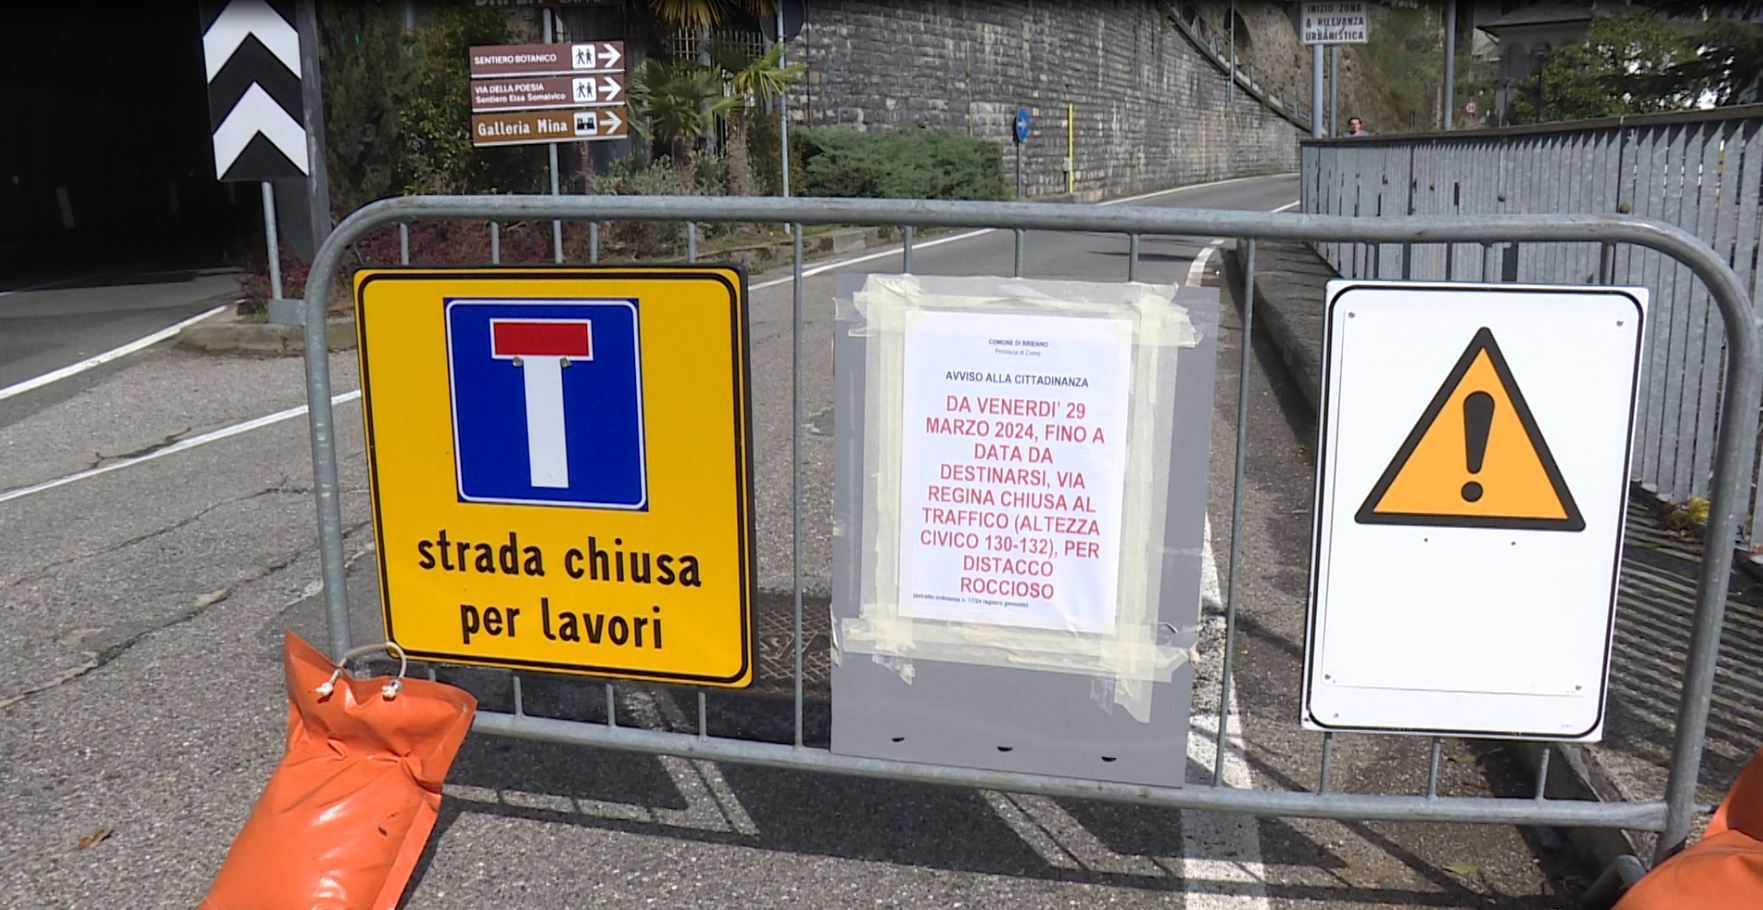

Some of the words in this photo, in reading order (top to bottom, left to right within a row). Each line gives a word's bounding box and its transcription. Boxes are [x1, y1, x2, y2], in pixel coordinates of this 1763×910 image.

[1308, 4, 1333, 13] INIZIO
[1339, 4, 1361, 12] ZONA
[1306, 18, 1312, 28] A
[1318, 17, 1364, 26] RILEVANZA
[1306, 31, 1364, 41] URBANISTICA
[474, 56, 514, 65] SENTIERO
[515, 54, 557, 63] BOTANICO
[474, 85, 488, 94] VIA
[490, 84, 514, 93] DELLA
[515, 83, 544, 92] POESIA
[476, 96, 507, 104] Sentiero
[478, 120, 530, 136] Galleria
[538, 118, 568, 133] Mina
[946, 371, 983, 382] AVVISO
[986, 373, 1012, 384] ALLA
[1014, 374, 1088, 387] CITTADINANZA
[946, 395, 971, 412] DA
[977, 397, 1060, 418] VENERDI'
[1066, 402, 1086, 419] 29
[926, 417, 989, 436] MARZO
[995, 421, 1038, 442] 2024,
[1045, 425, 1086, 443] FINO
[1092, 428, 1105, 444] A
[974, 443, 1022, 462] DATA
[1028, 447, 1054, 464] DA
[940, 464, 1050, 488] DESTINARSI,
[1057, 471, 1085, 489] VIA
[928, 486, 995, 506] REGINA
[1001, 491, 1067, 510] CHIUSA
[1072, 496, 1096, 512] AL
[923, 507, 1008, 529] TRAFFICO
[1015, 514, 1100, 536] (ALTEZZA
[920, 530, 979, 549] CIVICO
[985, 535, 1058, 558] 130-132),
[1065, 540, 1100, 558] PER
[418, 529, 545, 576] strada
[564, 536, 702, 587] chiusa
[963, 555, 1054, 577] DISTACCO
[960, 577, 1054, 600] ROCCIOSO
[460, 603, 520, 645] per
[541, 597, 662, 649] lavori
